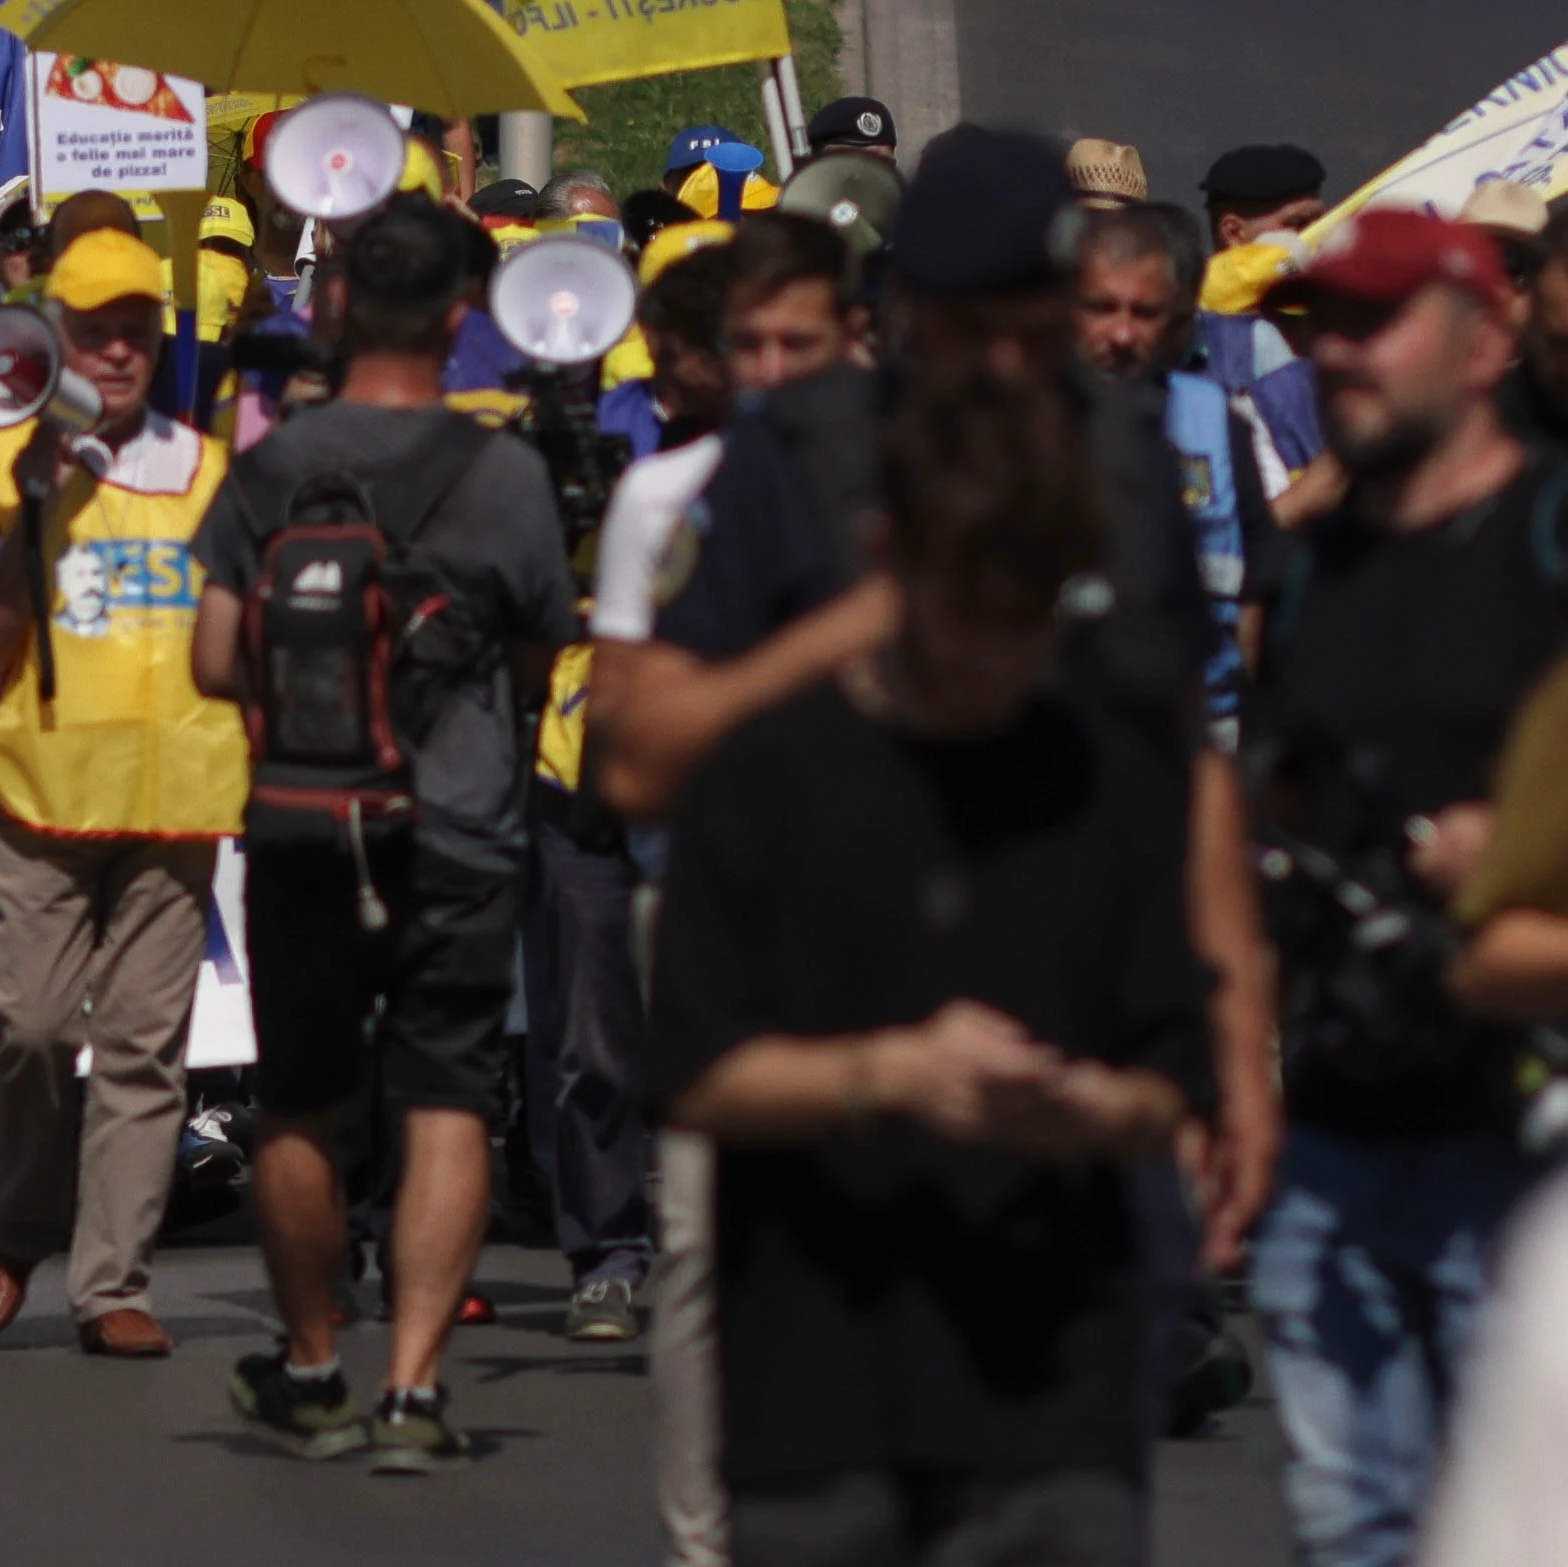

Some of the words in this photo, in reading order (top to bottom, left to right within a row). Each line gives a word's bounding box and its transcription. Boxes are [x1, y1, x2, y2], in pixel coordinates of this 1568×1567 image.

[137, 128, 194, 142] merită
[152, 147, 196, 159] mare
[91, 166, 112, 178] de
